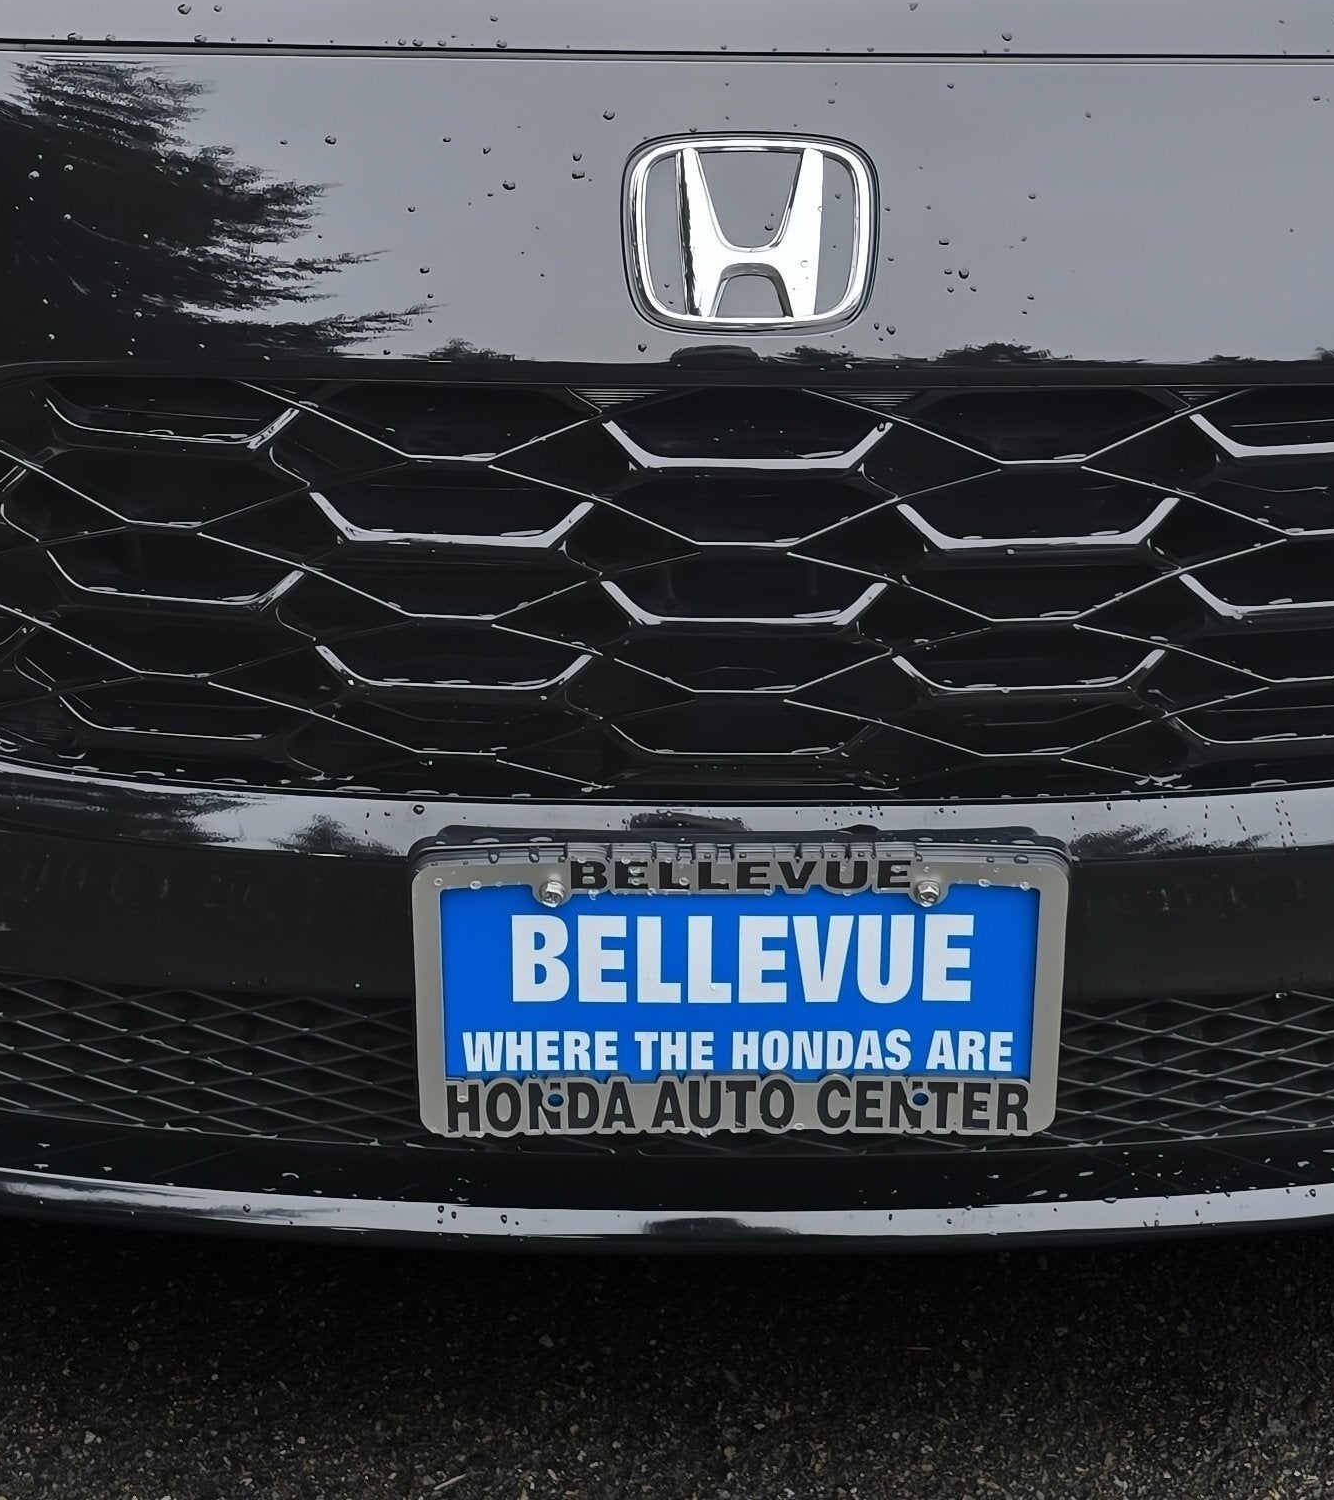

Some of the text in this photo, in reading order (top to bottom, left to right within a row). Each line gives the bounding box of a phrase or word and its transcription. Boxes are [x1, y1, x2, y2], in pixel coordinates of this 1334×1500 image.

[570, 861, 911, 890] BELLEVUE
[511, 915, 974, 1004] BELLEVUE
[463, 1030, 1014, 1073] WHERE THE HONDAS ARE
[446, 1080, 1031, 1134] HONDA AUTO CENTER
